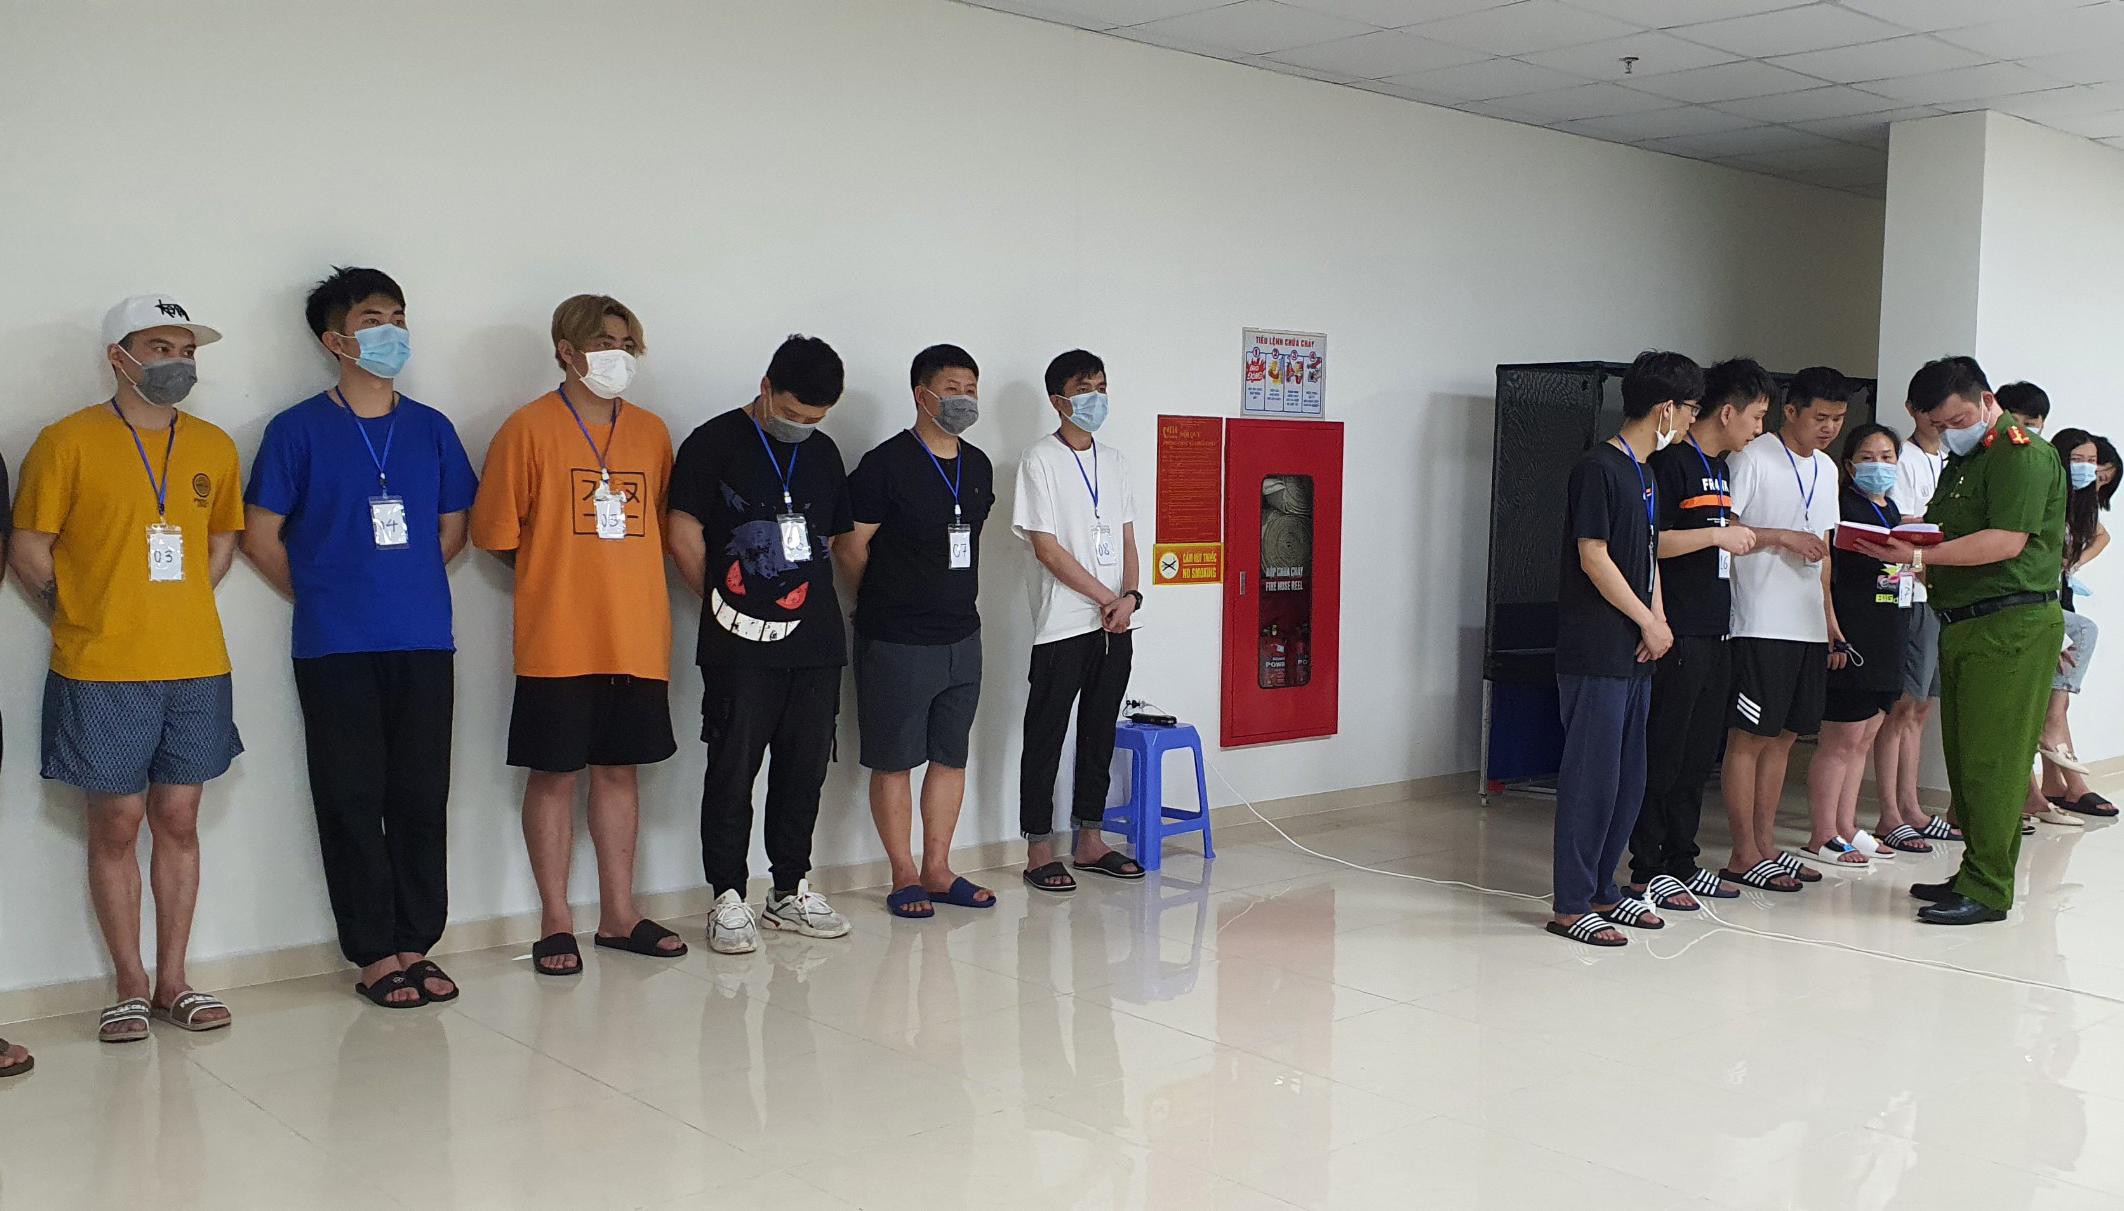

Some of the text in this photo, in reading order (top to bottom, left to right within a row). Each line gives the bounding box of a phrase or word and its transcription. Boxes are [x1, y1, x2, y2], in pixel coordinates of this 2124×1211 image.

[1098, 542, 1110, 557] 08
[154, 550, 173, 563] 03
[1720, 555, 1729, 570] 16
[1183, 567, 1217, 578] NO SMOKING
[1265, 580, 1303, 591] FIRE HOSE REEL
